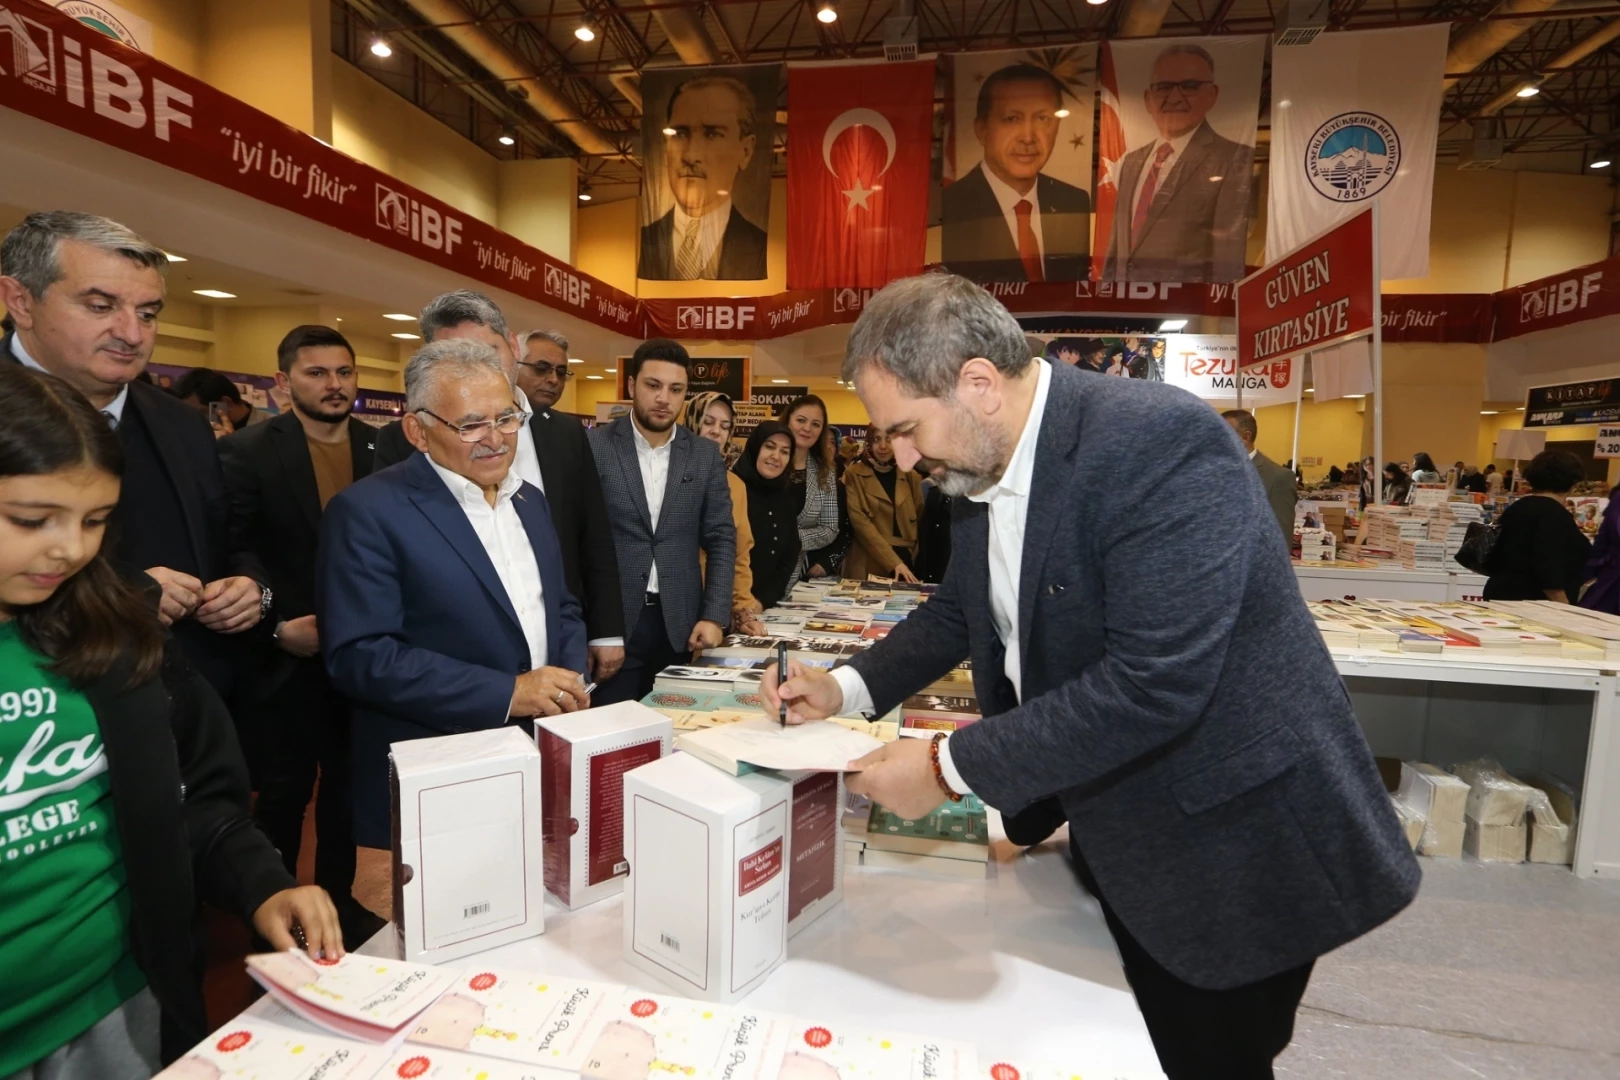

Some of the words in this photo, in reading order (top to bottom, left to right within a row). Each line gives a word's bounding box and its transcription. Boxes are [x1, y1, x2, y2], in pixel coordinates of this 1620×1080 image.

[1309, 138, 1323, 178] KAYSERİ
[1320, 116, 1378, 139] BÜYÜKŞEHİR
[1377, 123, 1398, 177] BELEDİYESİ
[269, 149, 303, 186] bir
[1337, 187, 1366, 199] 1869
[494, 250, 510, 272] bir
[1265, 250, 1331, 309] GÜVEN
[607, 301, 617, 317] bir
[782, 309, 793, 322] bir
[1253, 297, 1350, 359] KIRTASİYE
[1179, 351, 1270, 377] Tezua
[1211, 377, 1267, 389] MANGA
[1546, 387, 1595, 401] KİTAP
[1597, 443, 1606, 453] %
[1607, 444, 1620, 453] 20
